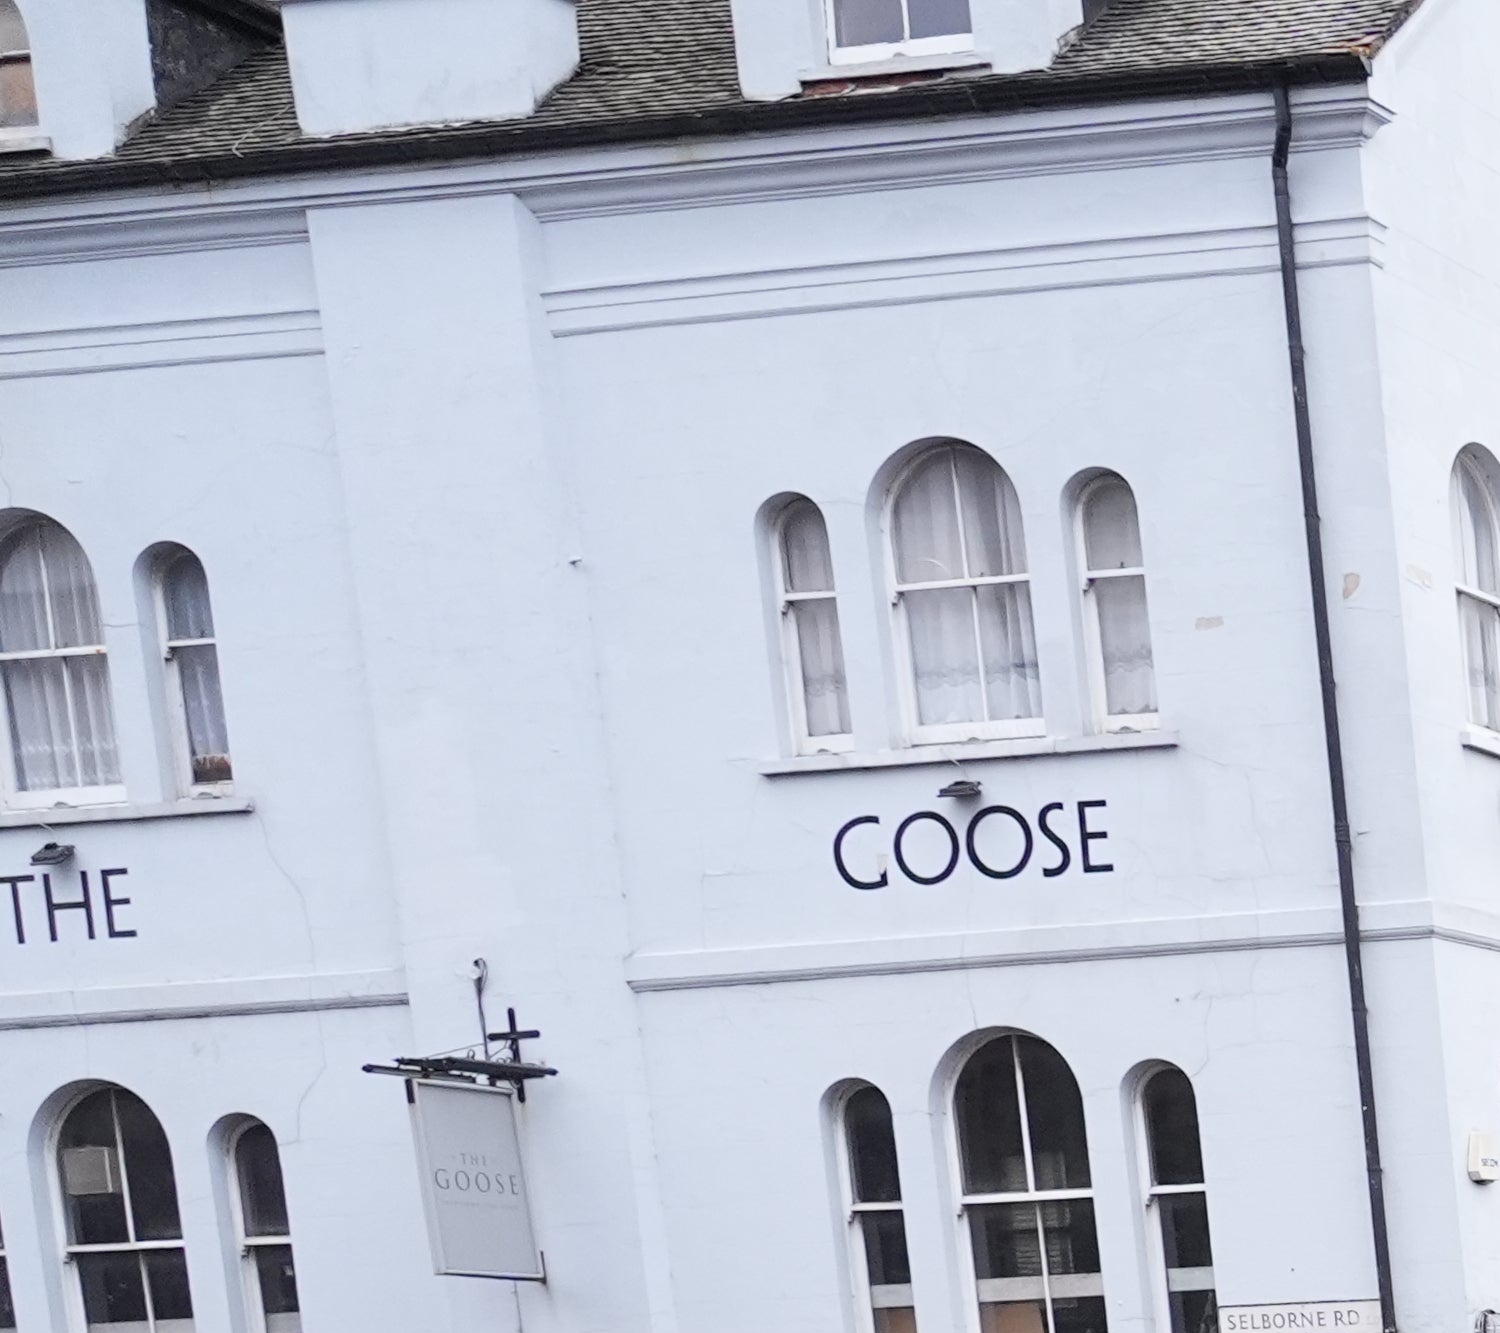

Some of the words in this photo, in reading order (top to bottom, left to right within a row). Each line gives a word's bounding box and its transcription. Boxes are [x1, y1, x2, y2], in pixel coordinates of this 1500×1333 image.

[833, 799, 1115, 891] GOOSE
[0, 868, 138, 945] THE
[434, 1168, 520, 1196] GOOSE
[1227, 1312, 1328, 1331] SELBORNE
[1334, 1310, 1361, 1326] RD
